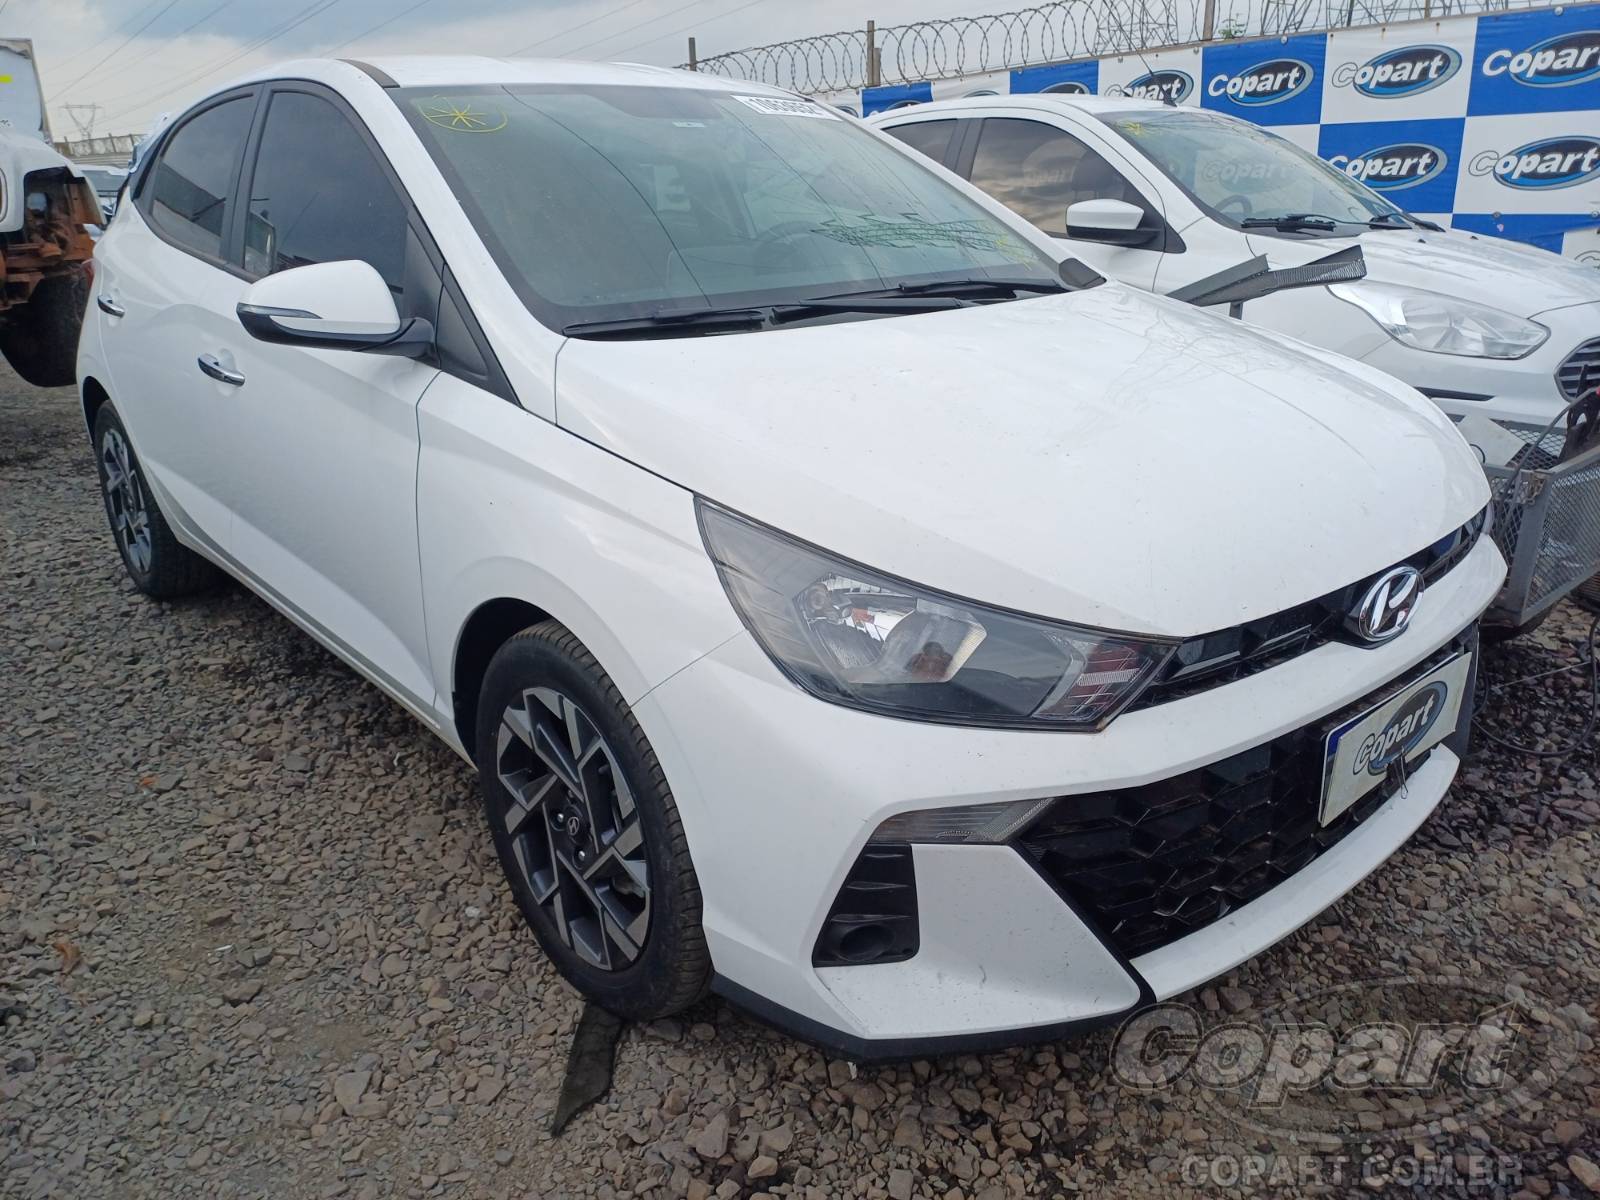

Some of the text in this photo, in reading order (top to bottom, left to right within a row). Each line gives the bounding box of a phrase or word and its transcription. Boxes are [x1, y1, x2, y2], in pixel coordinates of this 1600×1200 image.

[1332, 53, 1444, 90] Copart
[1482, 46, 1600, 79] Copar
[1208, 66, 1301, 99] Copart
[1468, 146, 1599, 180] Copart
[1352, 692, 1436, 776] Copart
